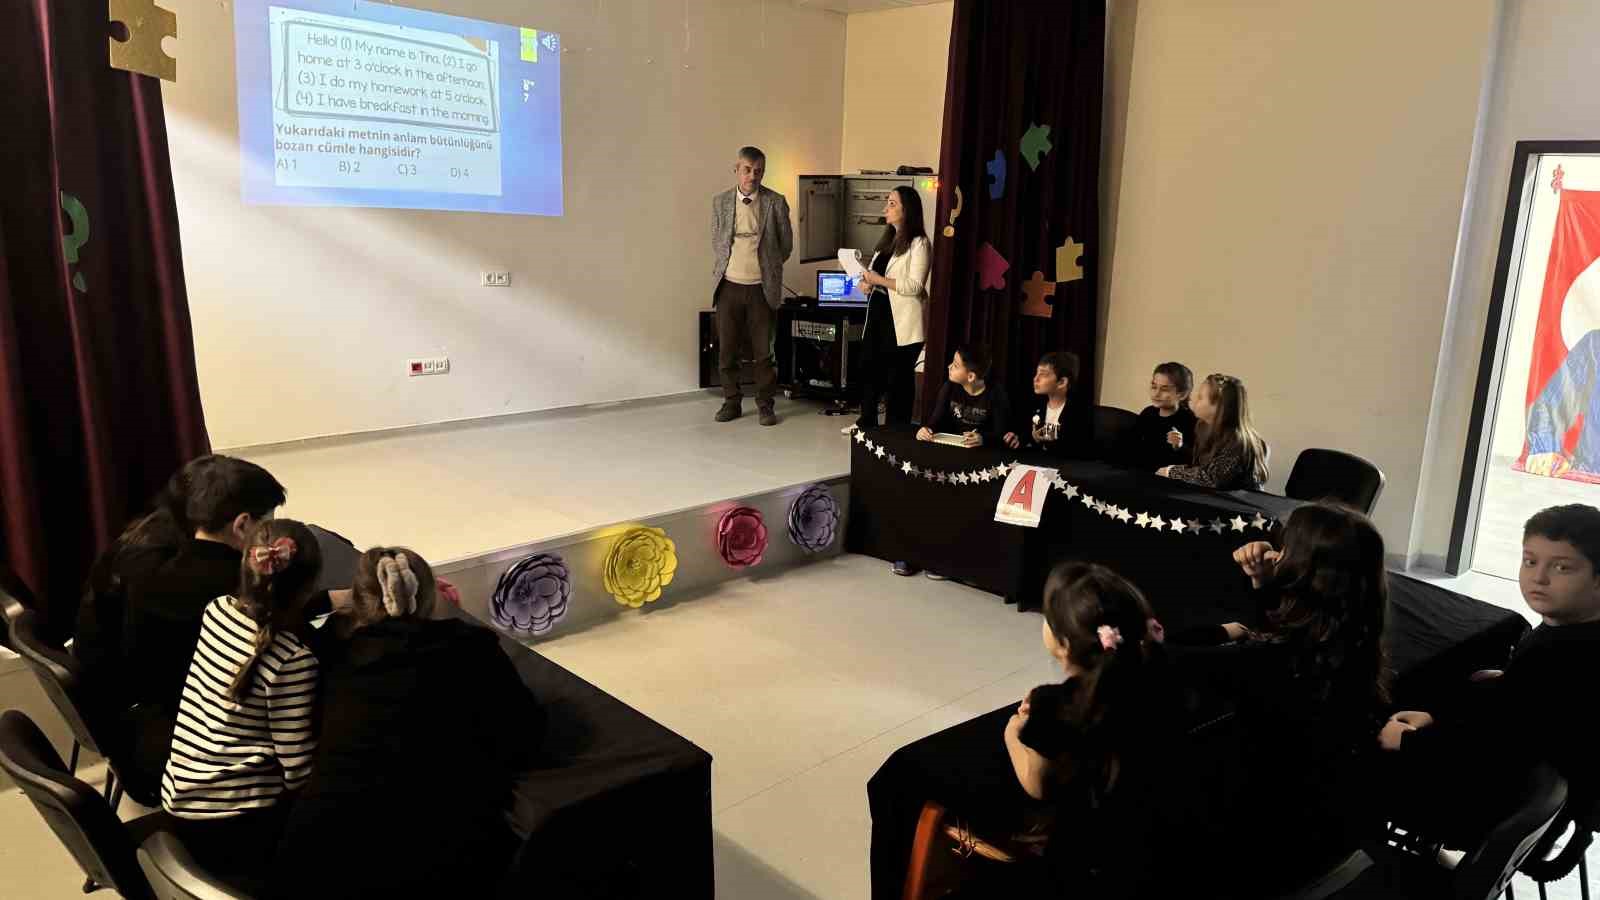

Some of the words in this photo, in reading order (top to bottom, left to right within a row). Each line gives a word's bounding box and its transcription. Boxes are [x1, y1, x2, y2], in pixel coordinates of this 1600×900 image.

[297, 50, 333, 66] home
[336, 55, 351, 69] at
[353, 58, 361, 71] 3
[405, 66, 413, 77] in
[415, 68, 433, 81] the
[307, 31, 337, 47] Hello!
[355, 40, 373, 55] My
[375, 45, 406, 58] name
[408, 48, 417, 60] is
[442, 54, 456, 67] (2)
[458, 58, 464, 69] I
[466, 63, 477, 73] go
[298, 69, 316, 85] (3)
[319, 73, 327, 86] I
[329, 75, 346, 88] do
[348, 79, 368, 93] my
[370, 80, 426, 98] homework
[430, 88, 443, 100] at
[445, 89, 453, 102] 5
[295, 90, 313, 107] (4)
[316, 92, 324, 106] I
[328, 95, 357, 109] have
[359, 97, 417, 115] breakfast
[420, 105, 430, 116] in
[431, 104, 449, 119] the
[275, 122, 345, 139] Yukarıdaki
[348, 129, 391, 141] metnin
[393, 131, 428, 145] anlam
[429, 133, 494, 152] bütünlüğünü
[275, 138, 314, 153] bozan
[317, 141, 356, 155] cümle
[359, 143, 422, 160] hangisidir?
[276, 158, 289, 170] A)
[291, 159, 298, 171] 1
[338, 160, 352, 175] B)
[353, 160, 361, 174] 2
[398, 163, 408, 176] C)
[410, 164, 418, 176] 3
[450, 167, 461, 178] D)
[1006, 469, 1037, 513] A
